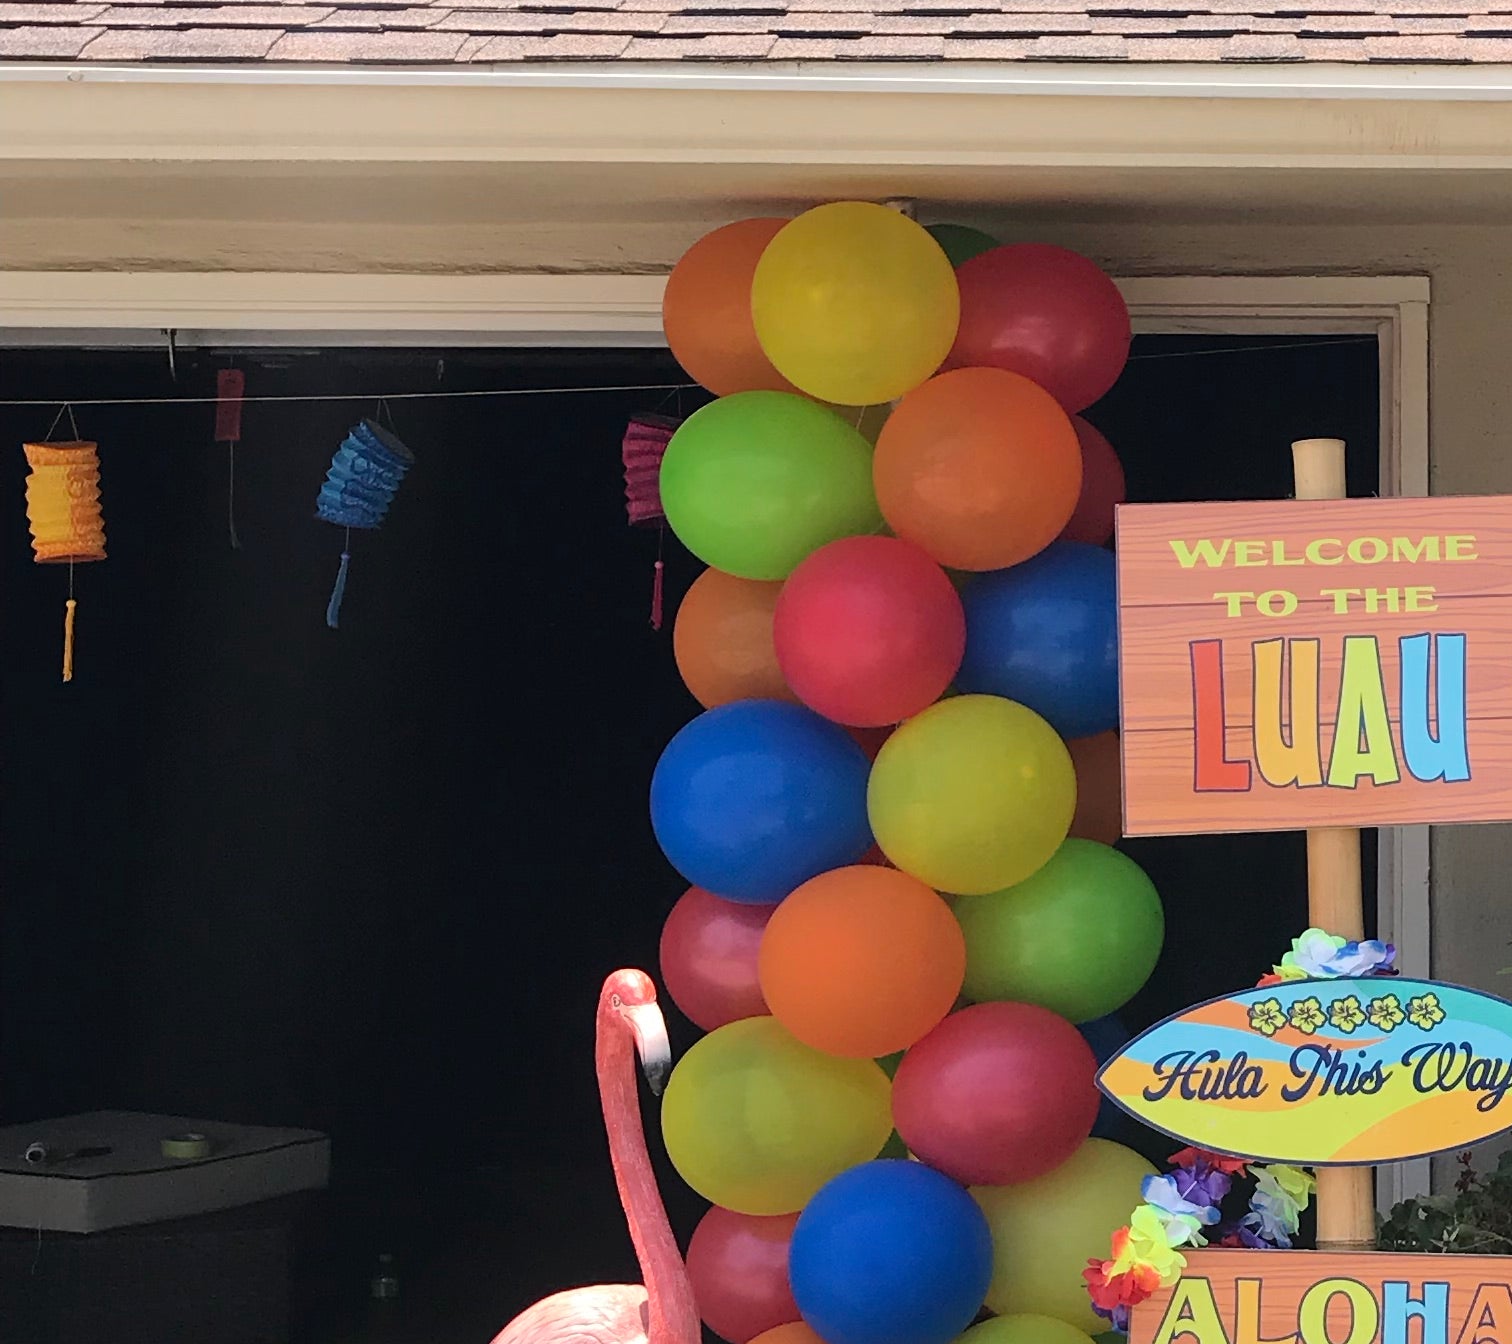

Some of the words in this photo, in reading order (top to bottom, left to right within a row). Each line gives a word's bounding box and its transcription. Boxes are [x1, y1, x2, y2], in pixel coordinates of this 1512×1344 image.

[1168, 534, 1479, 569] WELCOME
[1213, 590, 1298, 618] TO
[1320, 585, 1440, 615] THE
[1188, 632, 1472, 793] LUAU
[1142, 1049, 1268, 1102] Hula
[1280, 1042, 1393, 1102] This
